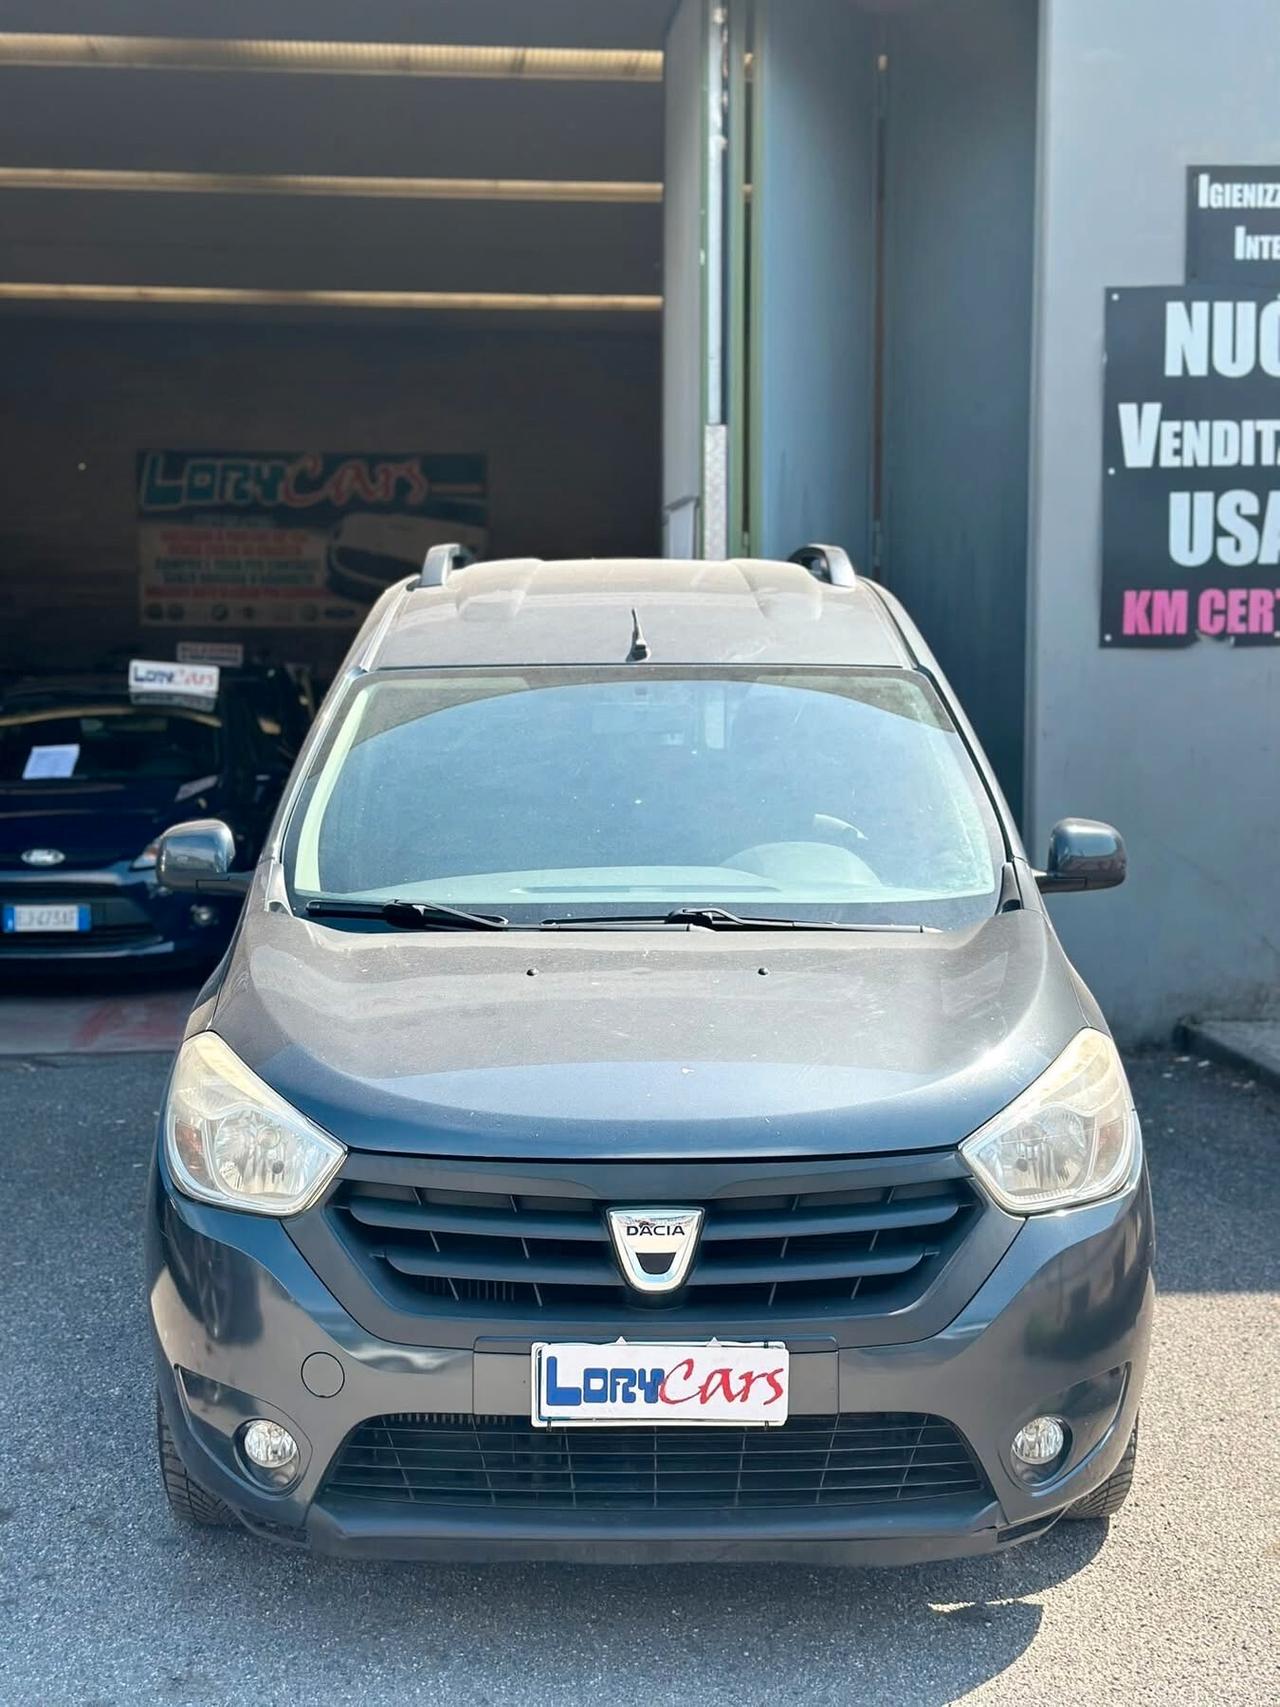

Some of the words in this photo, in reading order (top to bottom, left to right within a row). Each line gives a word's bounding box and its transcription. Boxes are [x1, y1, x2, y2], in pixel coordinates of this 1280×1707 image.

[1118, 402, 1280, 468] VENDIT
[1122, 589, 1189, 635] KM
[1197, 588, 1280, 636] CER
[626, 1225, 686, 1236] DACIA
